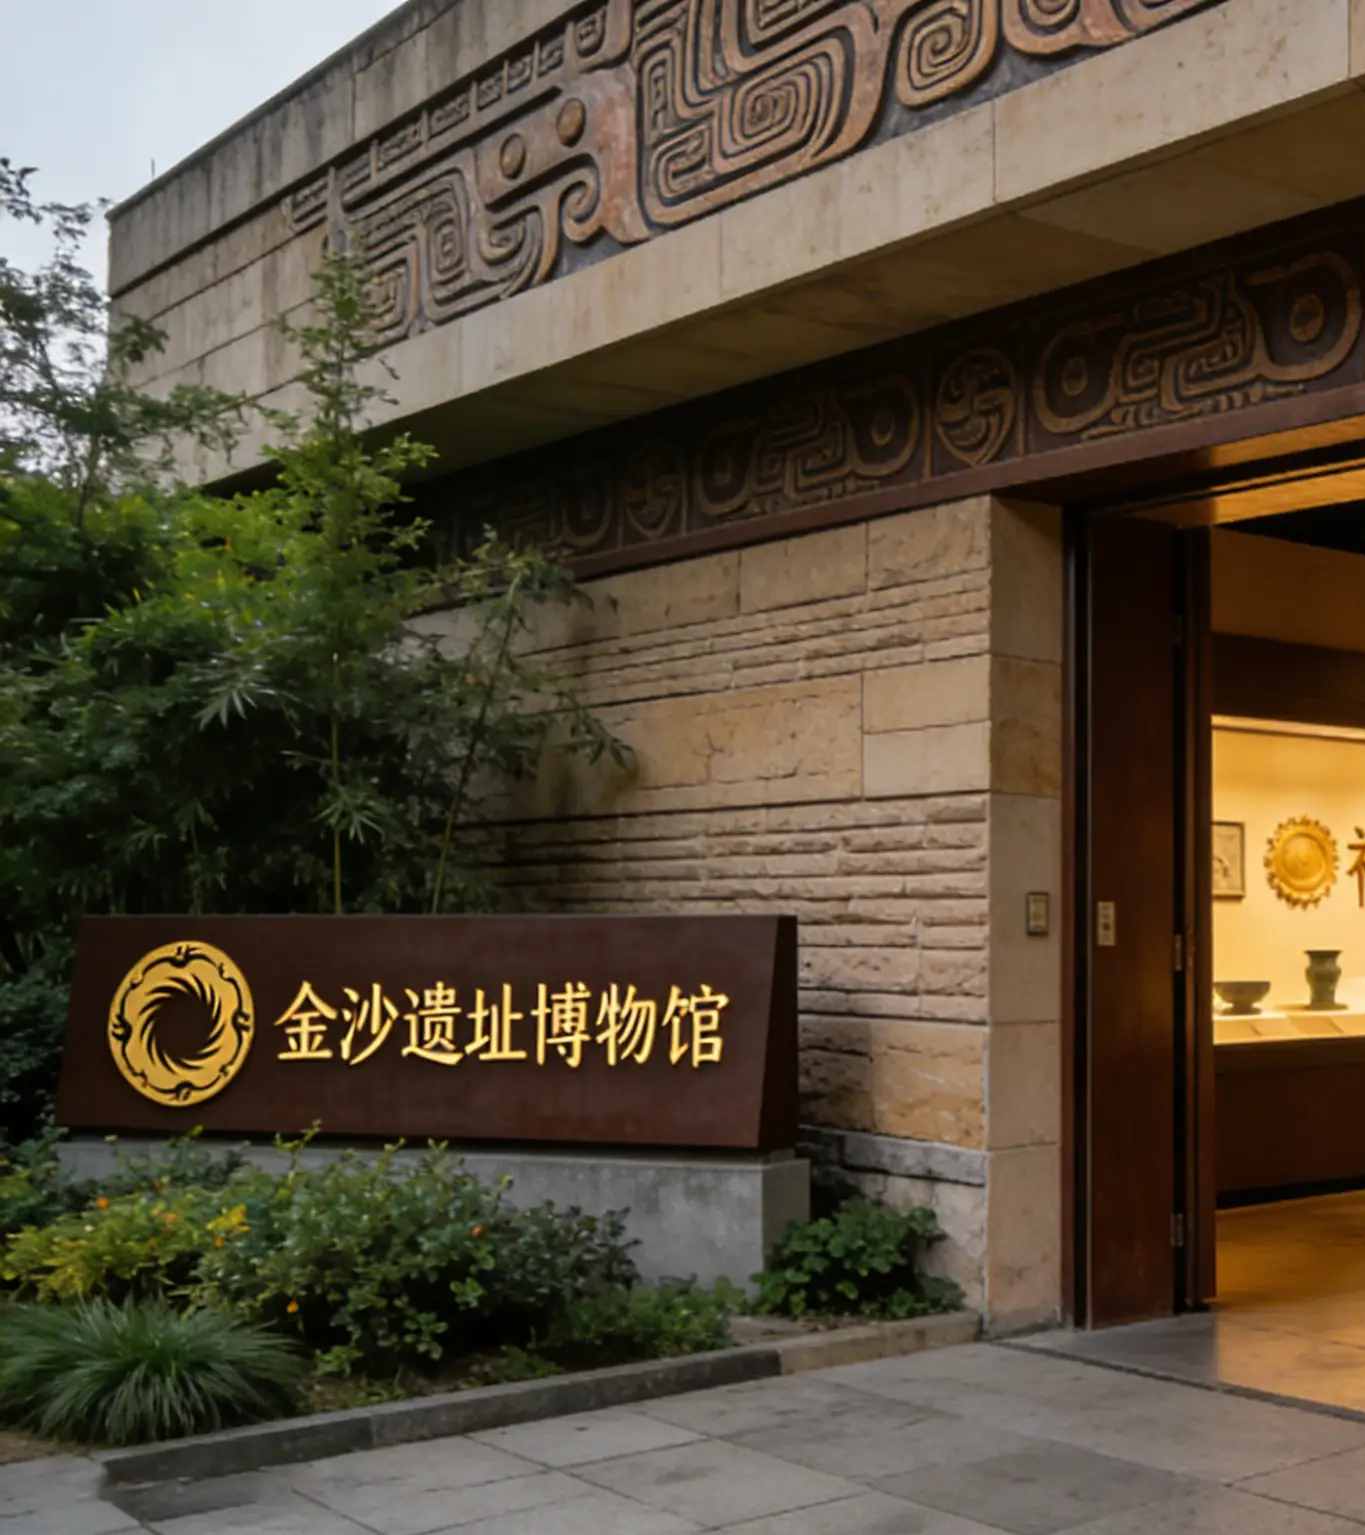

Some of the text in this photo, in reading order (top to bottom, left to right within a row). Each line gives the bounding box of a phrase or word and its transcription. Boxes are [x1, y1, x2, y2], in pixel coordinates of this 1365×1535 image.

[273, 980, 729, 1068] 金沙遗址博物馆
